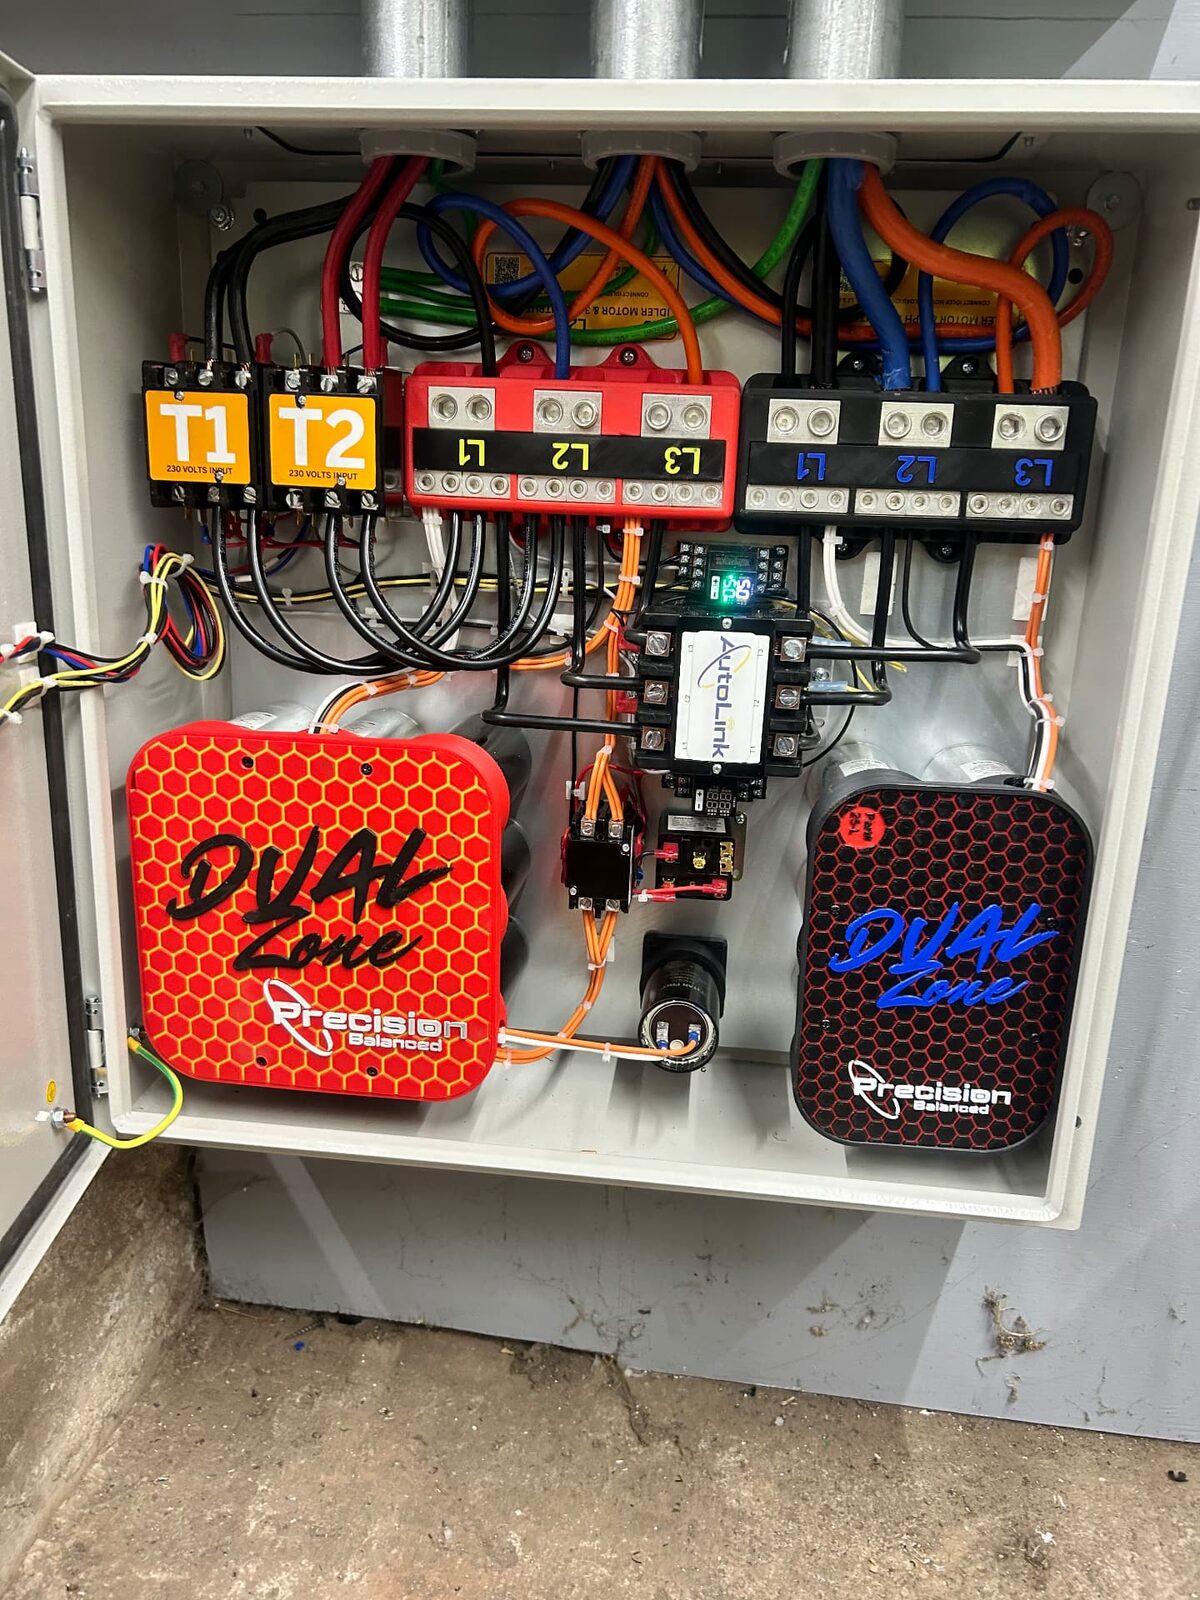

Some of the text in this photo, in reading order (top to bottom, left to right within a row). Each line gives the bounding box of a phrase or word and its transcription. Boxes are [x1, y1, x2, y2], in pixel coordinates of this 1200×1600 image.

[602, 306, 638, 316] MOTOR
[641, 306, 670, 317] IDLER
[159, 403, 236, 464] T1
[278, 407, 366, 470] T2
[458, 438, 485, 467] L1
[552, 442, 590, 471] L2
[664, 446, 701, 475] L3
[796, 452, 827, 481] L1
[166, 465, 181, 473] 230
[182, 466, 208, 475] VOLTS
[288, 469, 304, 478] 230
[305, 470, 332, 479] VOLTS
[895, 455, 937, 484] L2
[1014, 458, 1054, 487] L3
[712, 635, 737, 758] AutoLink
[233, 903, 424, 972] Zone
[876, 962, 1030, 1009] Zone
[272, 1001, 468, 1040] Precision
[348, 1032, 443, 1053] Balanced
[853, 1077, 1011, 1105] Precision
[913, 1099, 990, 1116] Balanced
